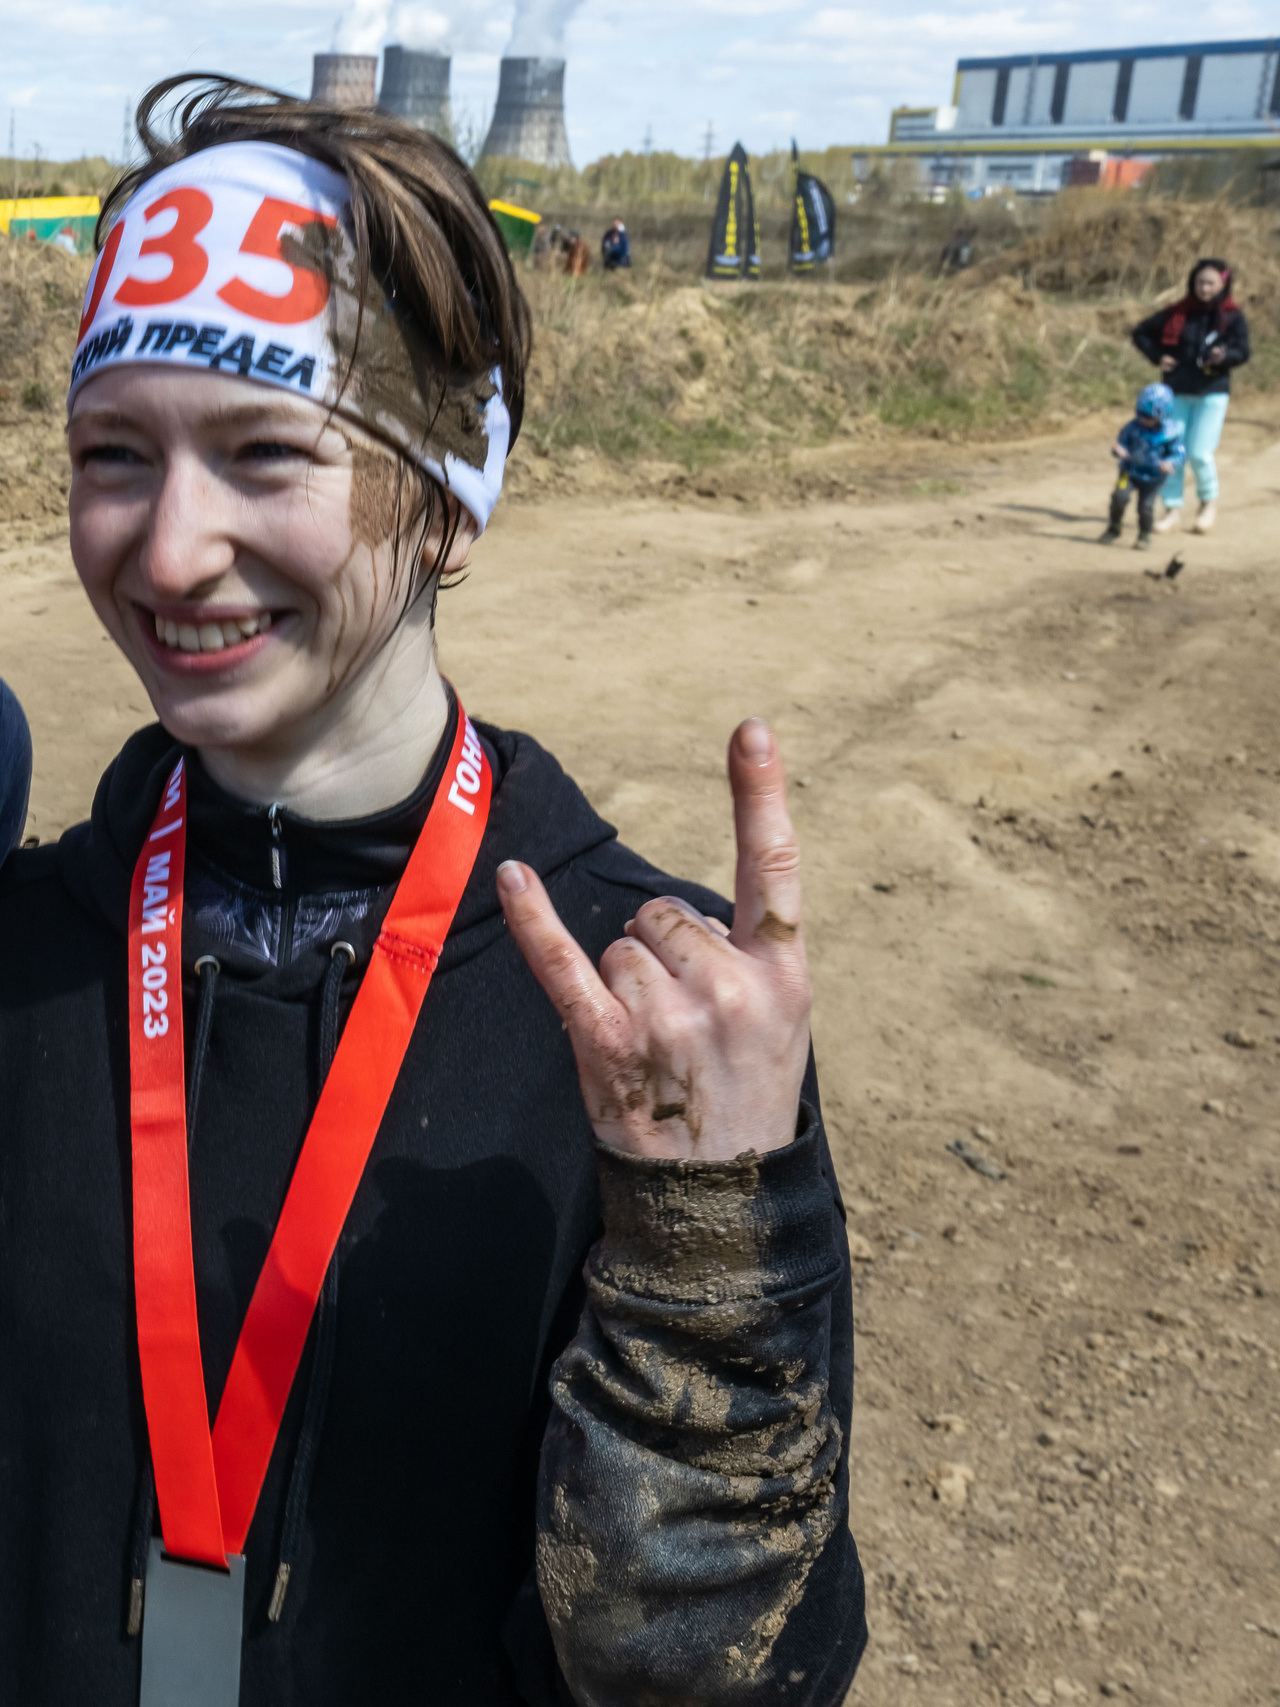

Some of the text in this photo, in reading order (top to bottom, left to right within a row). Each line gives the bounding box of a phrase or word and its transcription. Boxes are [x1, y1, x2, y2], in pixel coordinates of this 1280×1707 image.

[136, 321, 316, 391] ПРЕДЕЛ
[141, 851, 176, 935] МАЙ
[141, 941, 169, 1039] 2023
